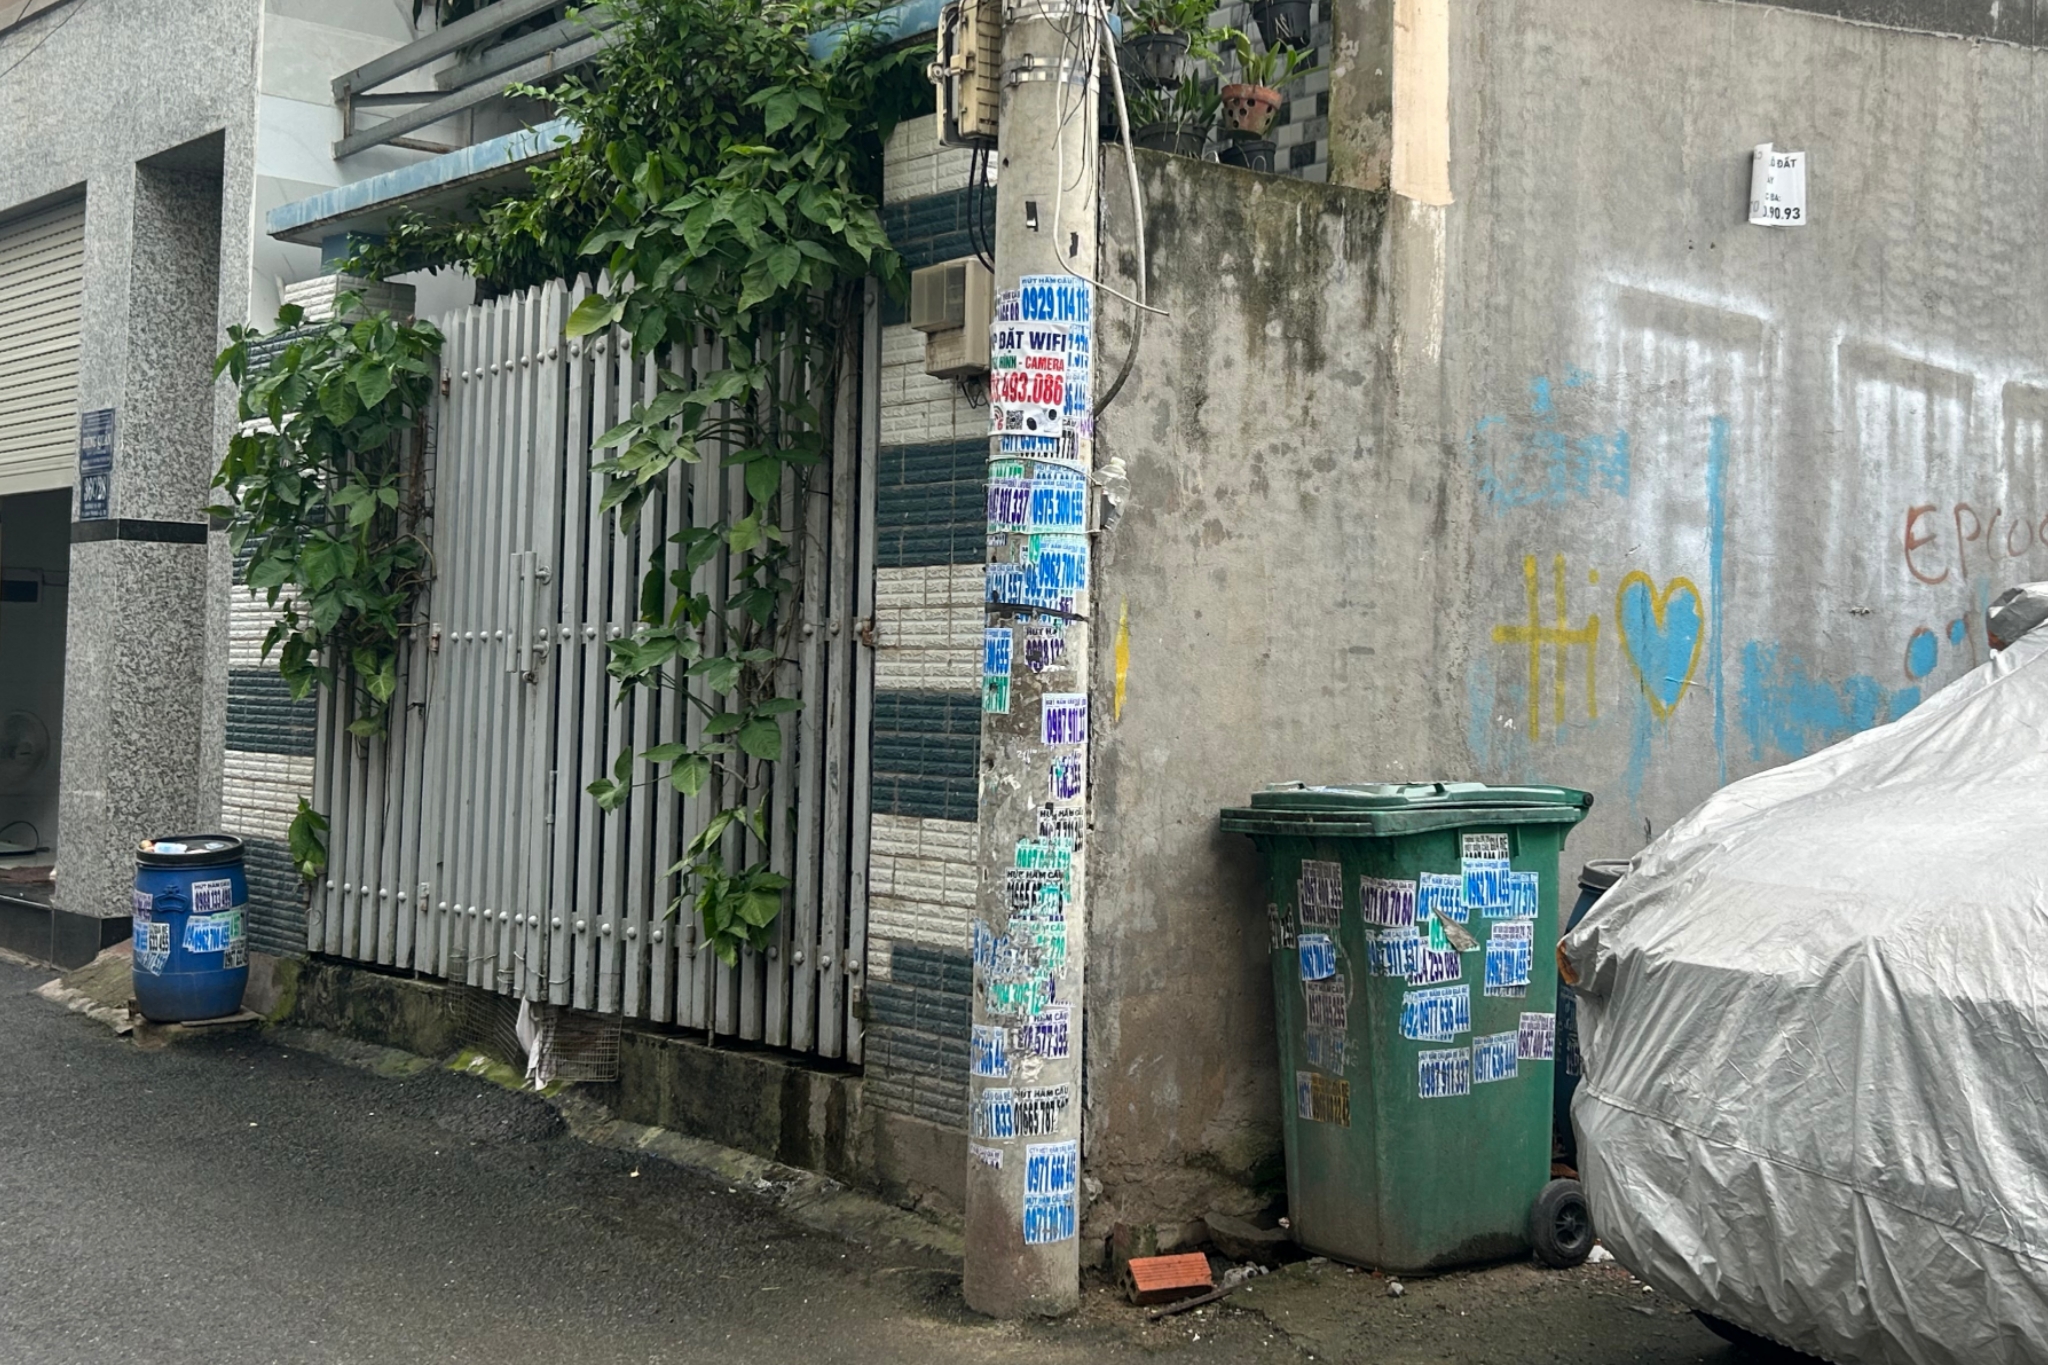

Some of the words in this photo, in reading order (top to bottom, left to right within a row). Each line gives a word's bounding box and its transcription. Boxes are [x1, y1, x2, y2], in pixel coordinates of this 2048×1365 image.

[1777, 156, 1797, 168] ĐẤT
[999, 327, 1024, 353] ĐẶT
[1029, 331, 1067, 352] WIFI
[1025, 355, 1064, 371] CAMERA
